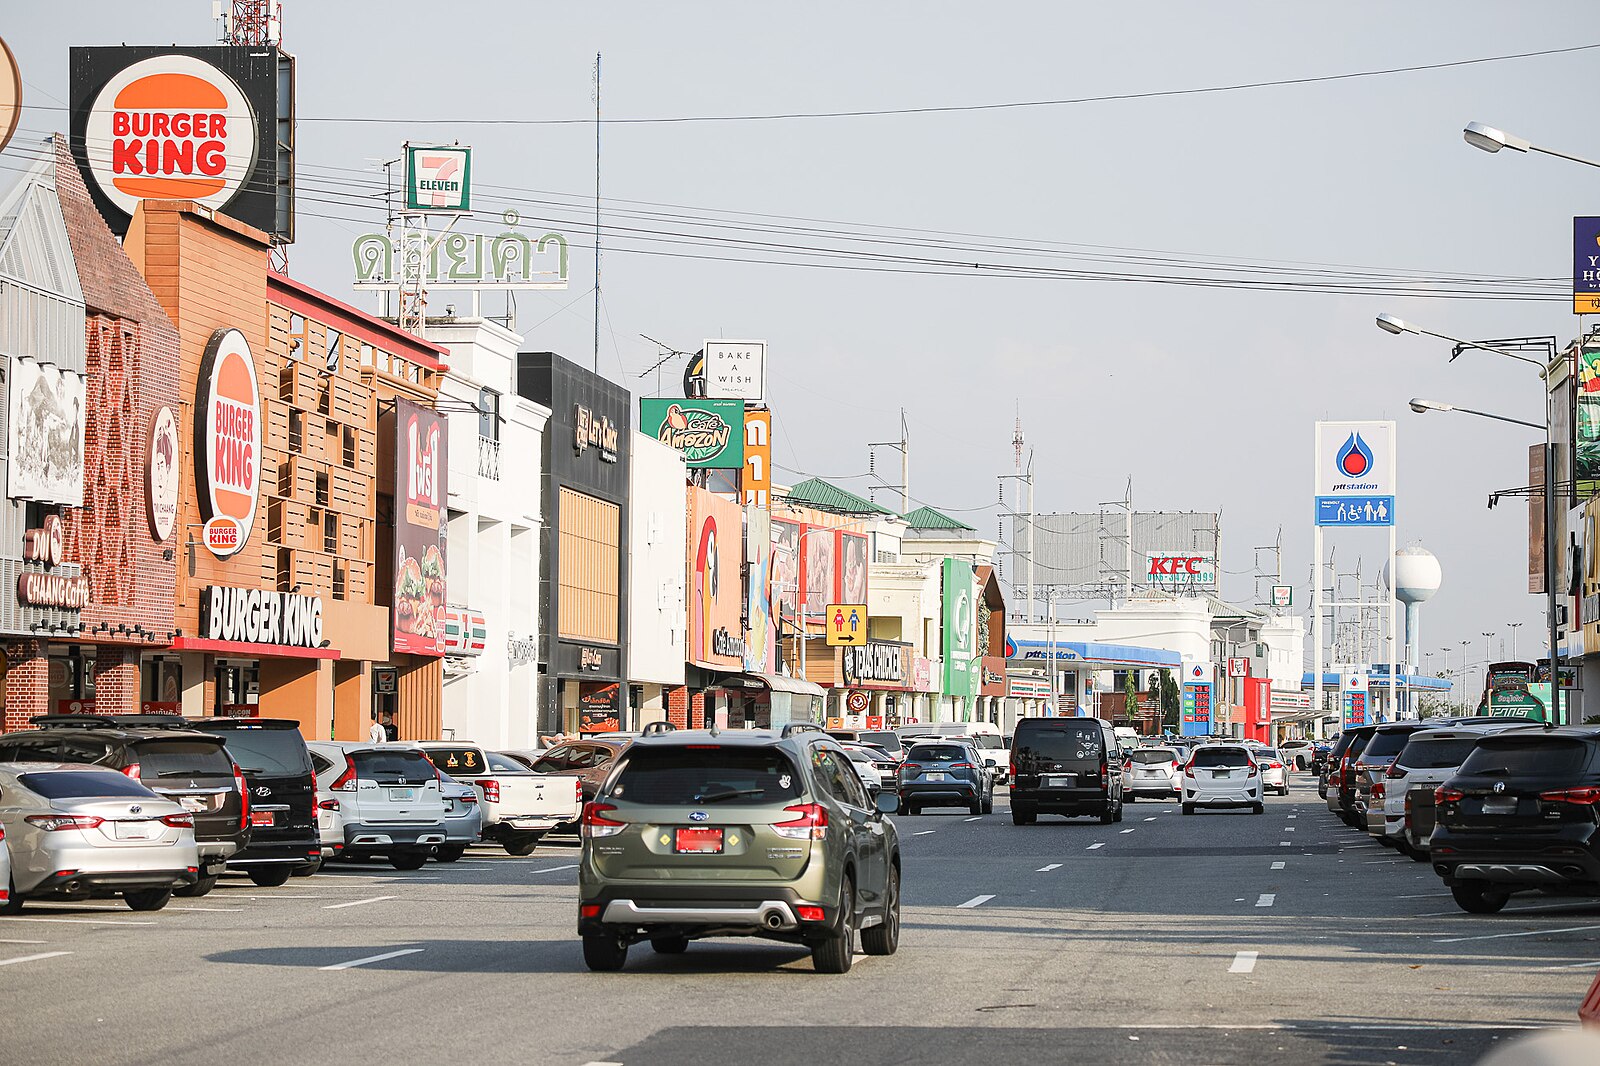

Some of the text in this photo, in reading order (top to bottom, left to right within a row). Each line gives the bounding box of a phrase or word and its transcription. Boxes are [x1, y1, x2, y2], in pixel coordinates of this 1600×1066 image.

[113, 111, 227, 139] BURGER
[113, 139, 227, 175] KING
[352, 209, 568, 280] ดอยคำ
[718, 351, 751, 360] BAKE
[717, 375, 751, 383] WISH
[215, 401, 253, 443] BURGER
[214, 435, 253, 490] KING
[32, 531, 50, 561] DOI
[209, 535, 237, 543] KING
[1149, 557, 1203, 574] KFC
[27, 574, 65, 606] CHAANG
[209, 586, 322, 648] BURGER KING
[874, 644, 901, 679] CHICKEN
